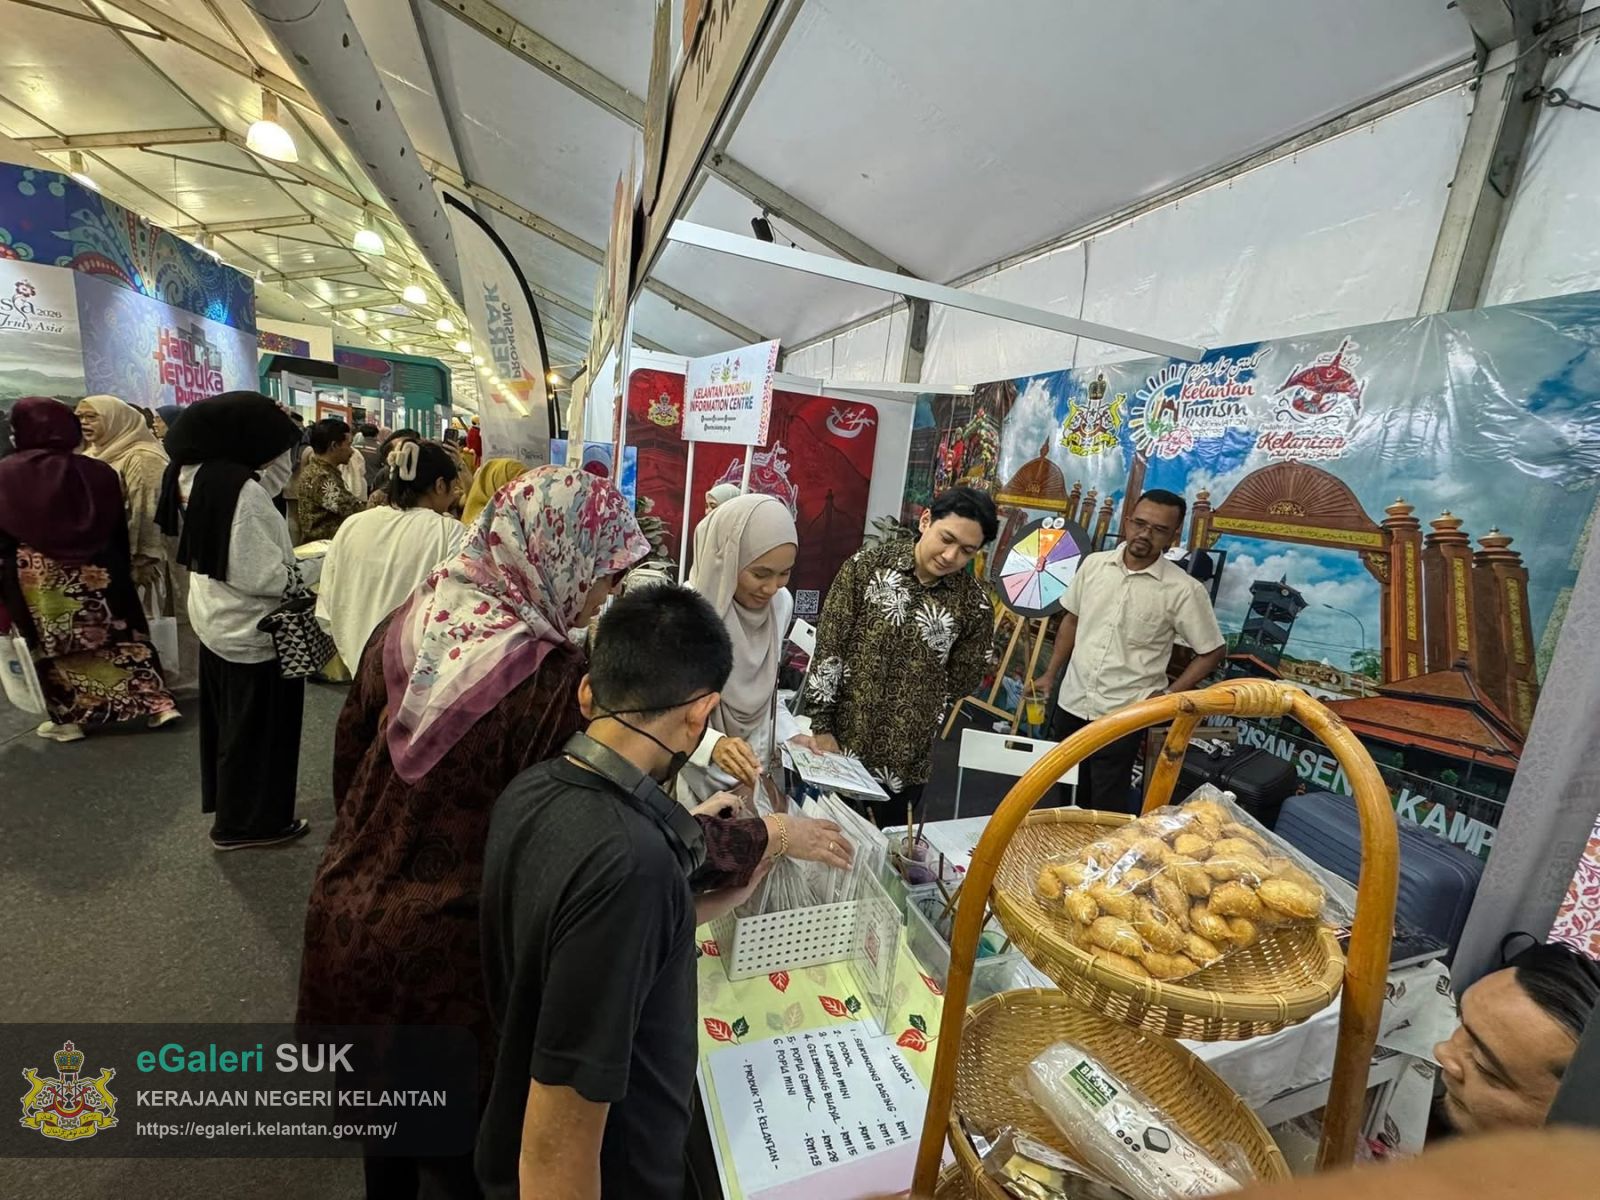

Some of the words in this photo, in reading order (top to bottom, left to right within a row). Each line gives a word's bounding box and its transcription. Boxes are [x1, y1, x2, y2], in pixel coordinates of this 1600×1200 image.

[35, 321, 64, 333] Asia
[152, 351, 224, 392] Terbuka
[694, 385, 723, 399] KELANTAN
[724, 381, 752, 396] TOURISM
[1181, 379, 1255, 400] Kelantan
[690, 398, 728, 412] INFORMATION
[729, 396, 754, 410] CENTRE
[1182, 401, 1248, 425] Tourism
[1256, 431, 1346, 451] Kelantan
[1295, 749, 1354, 797] SEN
[1395, 788, 1498, 857] KAMP
[838, 1041, 854, 1068] DODOL
[890, 1054, 913, 1083] HARGA
[743, 1064, 759, 1097] PRODUK
[776, 1049, 790, 1075] POPIA
[783, 1075, 796, 1096] MINI
[807, 1043, 830, 1091] GELEMBUNG
[824, 1092, 841, 1125] BUAYA
[798, 1072, 816, 1113] GEMUK
[837, 1078, 851, 1100] MINI
[875, 1083, 897, 1113] DAGING
[753, 1098, 764, 1114] TIC
[758, 1115, 780, 1162] KELANTAN
